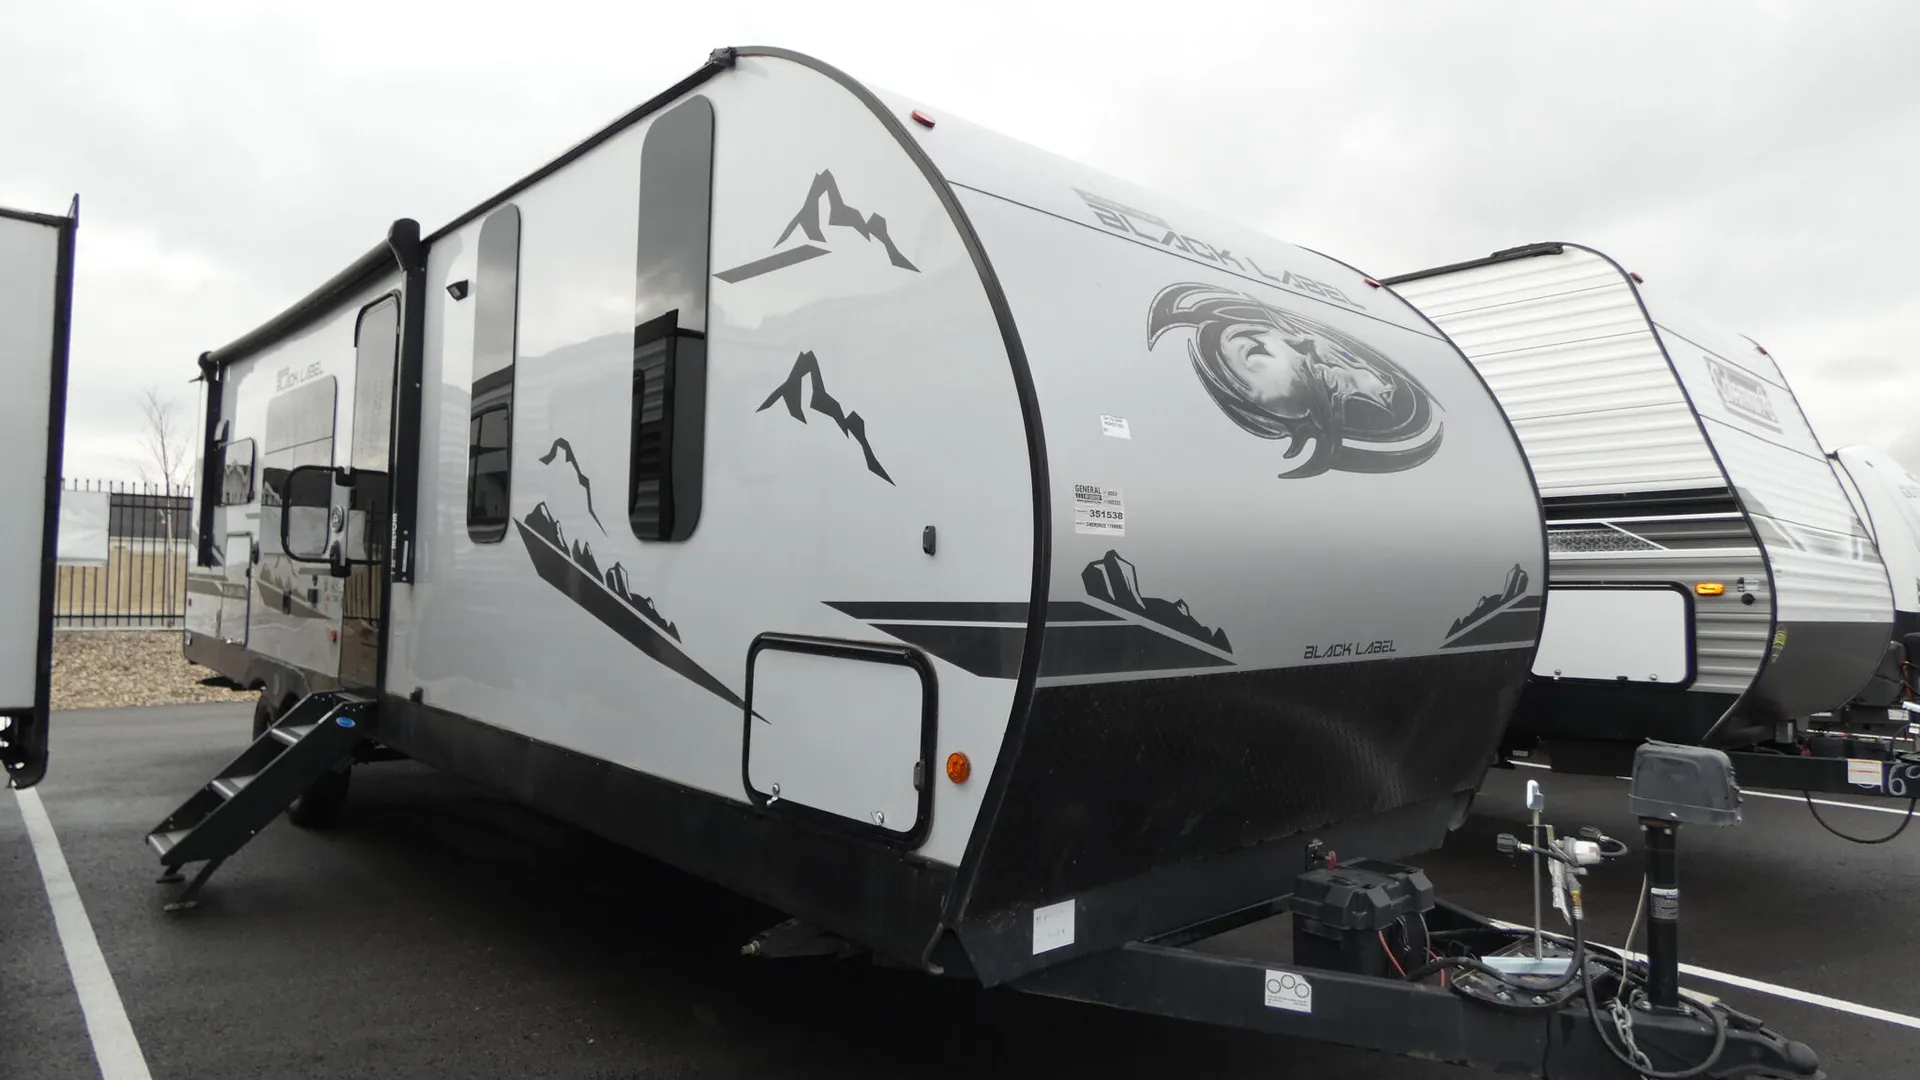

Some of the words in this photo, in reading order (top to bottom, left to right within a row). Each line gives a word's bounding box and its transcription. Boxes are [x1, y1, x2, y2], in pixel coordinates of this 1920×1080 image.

[1086, 203, 1246, 271] BLACK
[1244, 256, 1368, 311] LABEL
[1074, 484, 1102, 495] GENERAL
[1089, 509, 1124, 520] 351538
[1304, 642, 1353, 660] BLACK
[1355, 639, 1397, 656] LABEL
